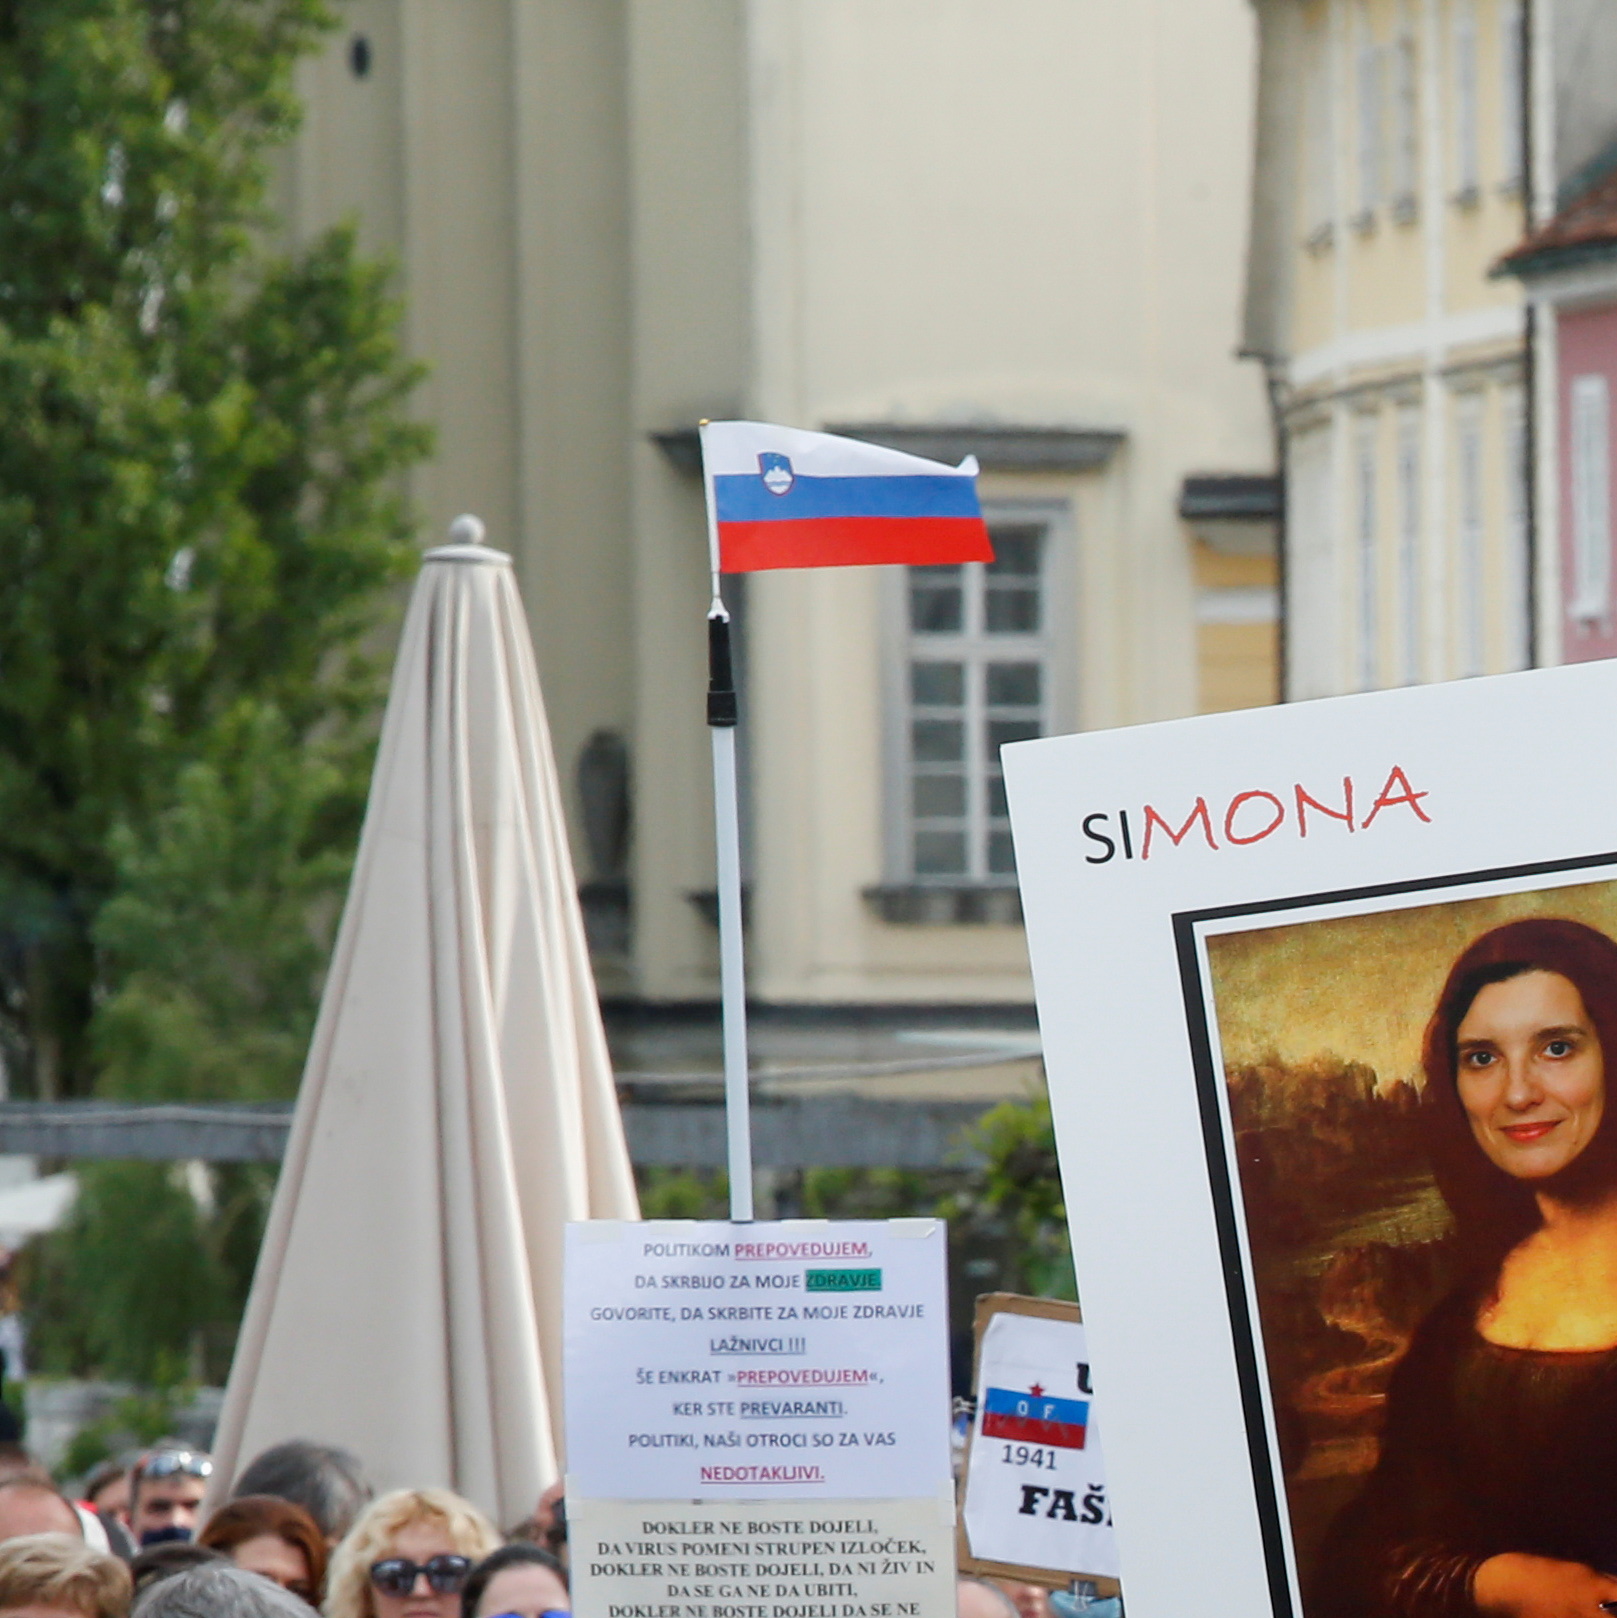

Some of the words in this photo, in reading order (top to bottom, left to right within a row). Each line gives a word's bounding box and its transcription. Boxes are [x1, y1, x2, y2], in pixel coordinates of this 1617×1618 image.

[1082, 765, 1432, 864] SIMONA
[644, 1244, 730, 1257] POLITIKOM
[735, 1243, 872, 1258] PREPOVEDUJEM,
[635, 1276, 656, 1289] DA
[730, 1275, 751, 1288] ZA
[756, 1275, 800, 1288] MOJE
[591, 1306, 676, 1322] GOVORITE,
[680, 1306, 703, 1320] DA
[708, 1306, 772, 1320] SKRBITE
[778, 1306, 798, 1320] ZA
[803, 1306, 848, 1320] MOJE
[853, 1305, 924, 1320] ZDRAVJE
[710, 1335, 783, 1353] LAŽNIVCI
[637, 1367, 655, 1384] ŠE
[660, 1371, 721, 1384] ENKRAT
[673, 1402, 703, 1415] KER
[708, 1402, 735, 1415] STE
[629, 1434, 698, 1449] POLITIKI,
[704, 1431, 741, 1447] NAŠI
[746, 1433, 807, 1447] OTROCI
[812, 1433, 835, 1447] SO
[839, 1433, 859, 1446] ZA
[862, 1432, 896, 1446] VAS
[1002, 1444, 1056, 1470] 1941
[700, 1466, 825, 1481] NEDOTAKLJIVI.
[1019, 1483, 1113, 1527] FAŠ
[643, 1521, 714, 1535] DOKLER
[720, 1521, 742, 1534] NE
[748, 1521, 805, 1534] BOSTE
[810, 1520, 878, 1535] DOJELI,
[598, 1542, 621, 1556] DA
[626, 1542, 677, 1555] VIRUS
[682, 1542, 750, 1555] POMENI
[755, 1542, 835, 1555] STRUPEN
[841, 1538, 926, 1556] IZLOČEK,
[591, 1563, 663, 1576] DOKLER
[668, 1563, 690, 1576] NE
[695, 1563, 751, 1576] BOSTE
[756, 1563, 824, 1577] DOJELI,
[829, 1562, 853, 1575] DA
[858, 1562, 876, 1575] NI
[881, 1558, 912, 1575] ŽIV
[917, 1562, 934, 1574] IN
[668, 1584, 691, 1597] DA
[695, 1584, 714, 1597] SE
[719, 1584, 743, 1597] GA
[747, 1584, 770, 1597] NE
[775, 1584, 799, 1597] DA
[805, 1584, 858, 1598] UBITI,
[609, 1605, 681, 1618] DOKLER
[686, 1605, 708, 1618] NE
[713, 1605, 768, 1618] BOSTE
[773, 1604, 837, 1617] DOJELI
[842, 1604, 867, 1617] DA
[871, 1603, 891, 1617] SE
[897, 1603, 920, 1616] NE
